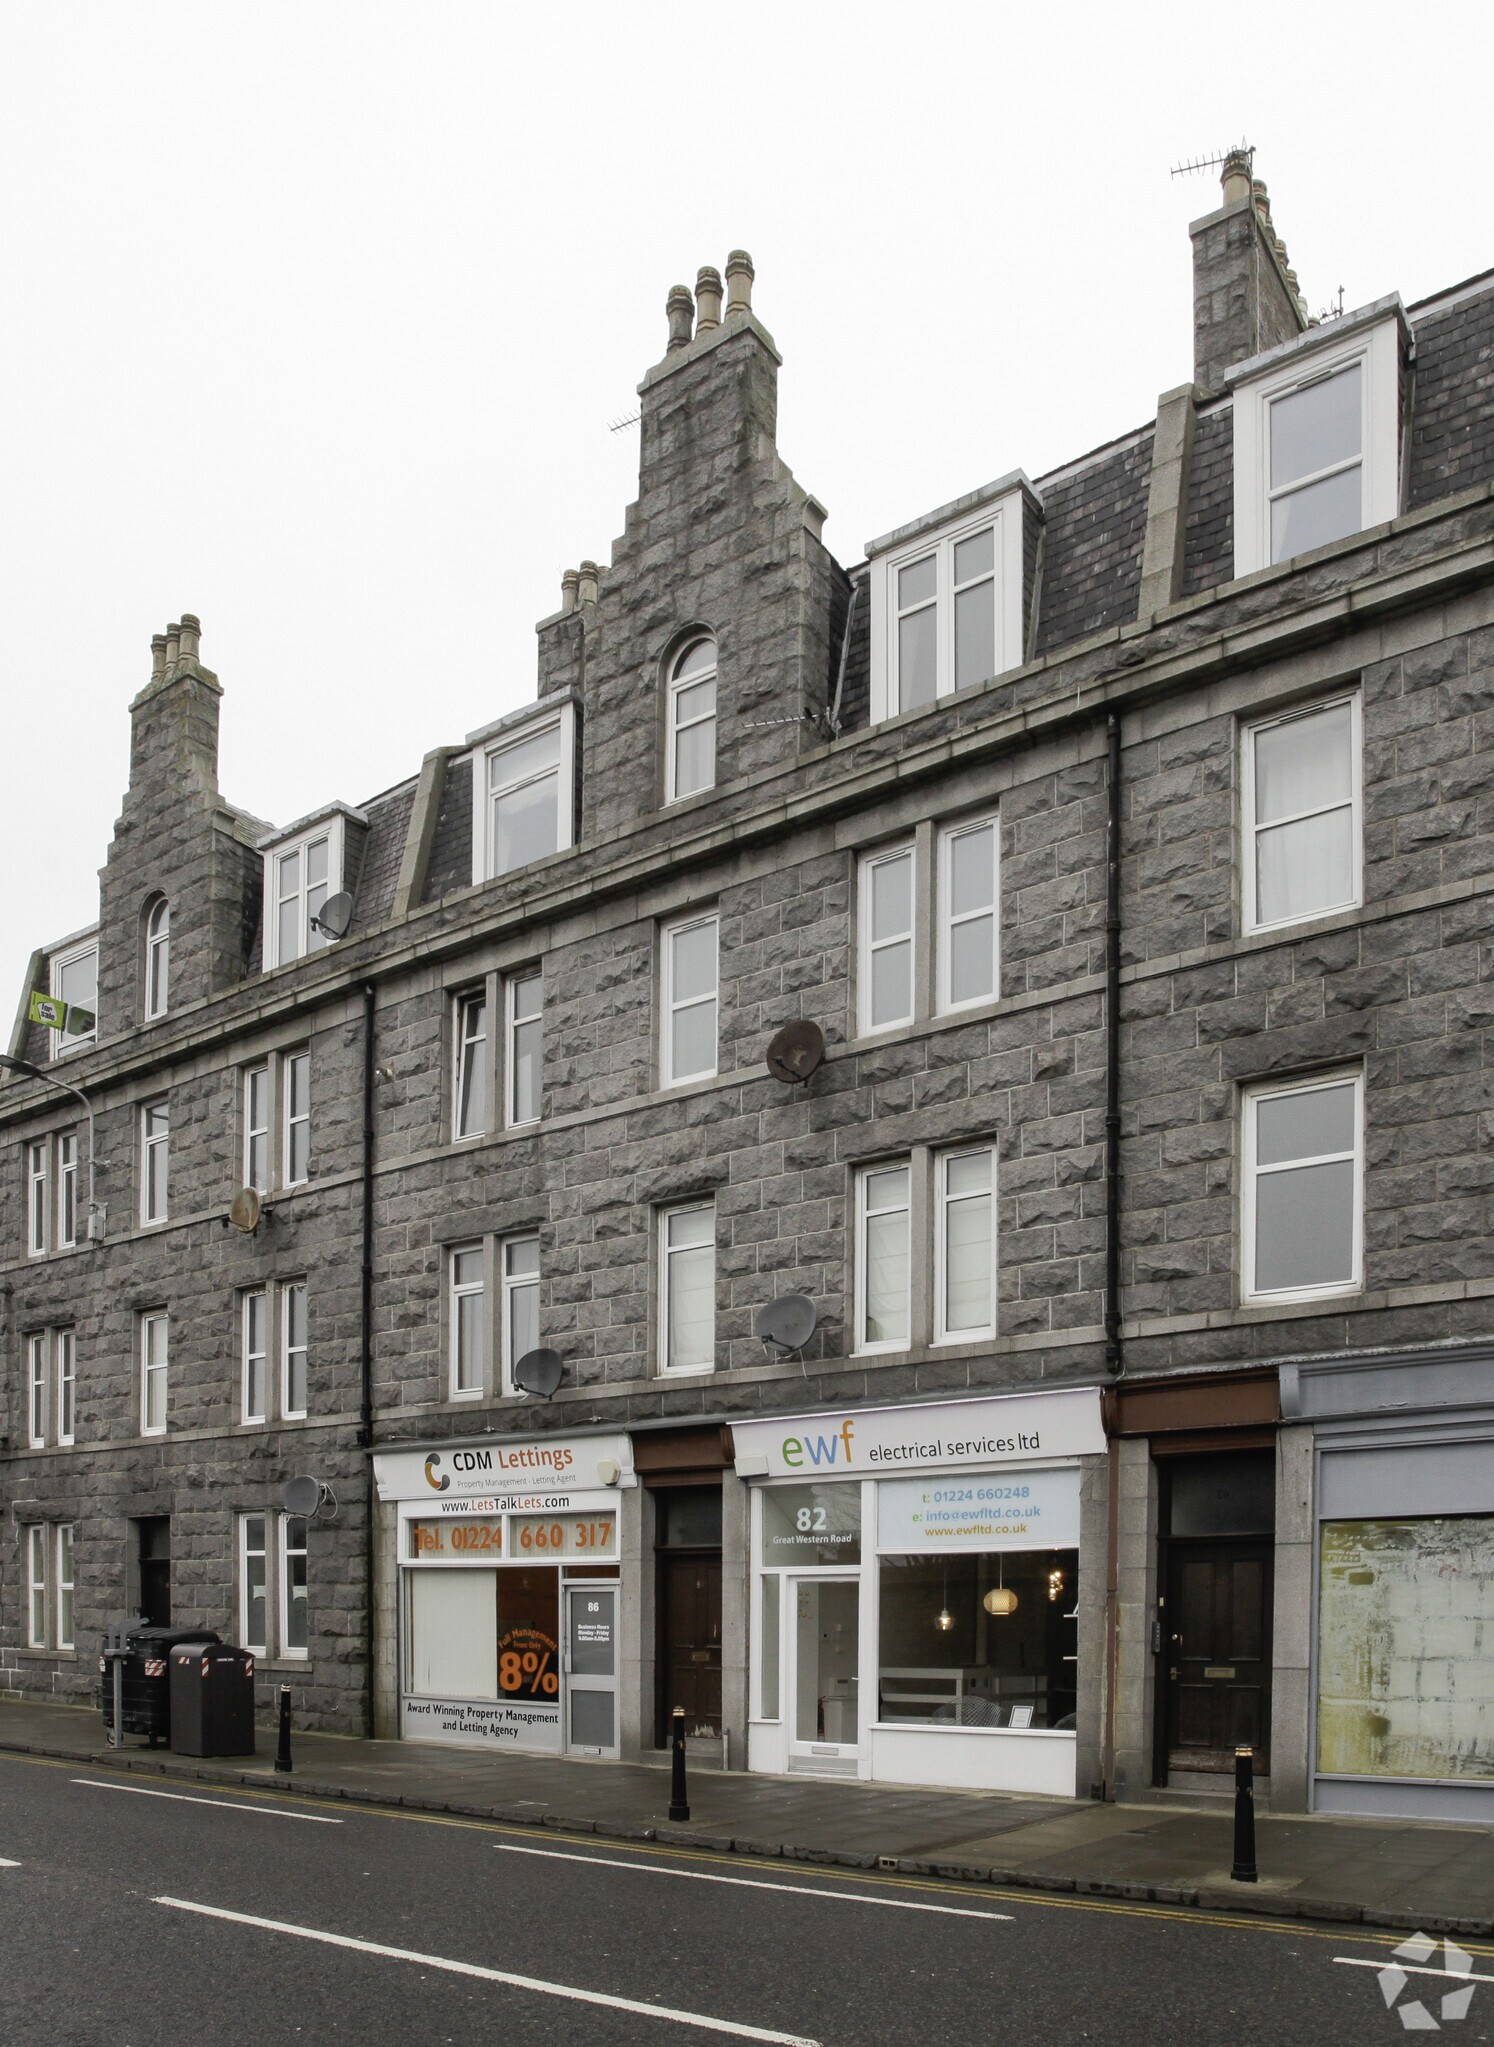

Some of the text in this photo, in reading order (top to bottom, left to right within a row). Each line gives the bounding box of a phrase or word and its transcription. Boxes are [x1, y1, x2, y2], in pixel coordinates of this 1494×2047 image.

[782, 1420, 854, 1467] ewf
[869, 1432, 1040, 1461] electrical services ltd
[453, 1446, 573, 1471] CDM Lettings
[457, 1480, 484, 1489] Property
[485, 1477, 527, 1488] Management
[532, 1474, 556, 1486] Letting
[556, 1474, 576, 1483] Agent
[442, 1496, 570, 1512] www.LetsTalkLets.com
[933, 1490, 973, 1502] 01224
[977, 1487, 1030, 1500] 660248
[796, 1507, 827, 1531] 82
[926, 1506, 1041, 1521] info@ewfltd.co.uk
[414, 1522, 612, 1551] Tel. 01224 660 317
[773, 1533, 852, 1544] Great Western Road
[925, 1523, 1027, 1536] www.ewfltd.co.uk
[587, 1602, 599, 1611] 86
[498, 1629, 557, 1651] Full Management
[500, 1651, 558, 1694] 8%
[407, 1702, 559, 1724] Award Winning Property Management
[442, 1721, 519, 1738] and Letting Agency
